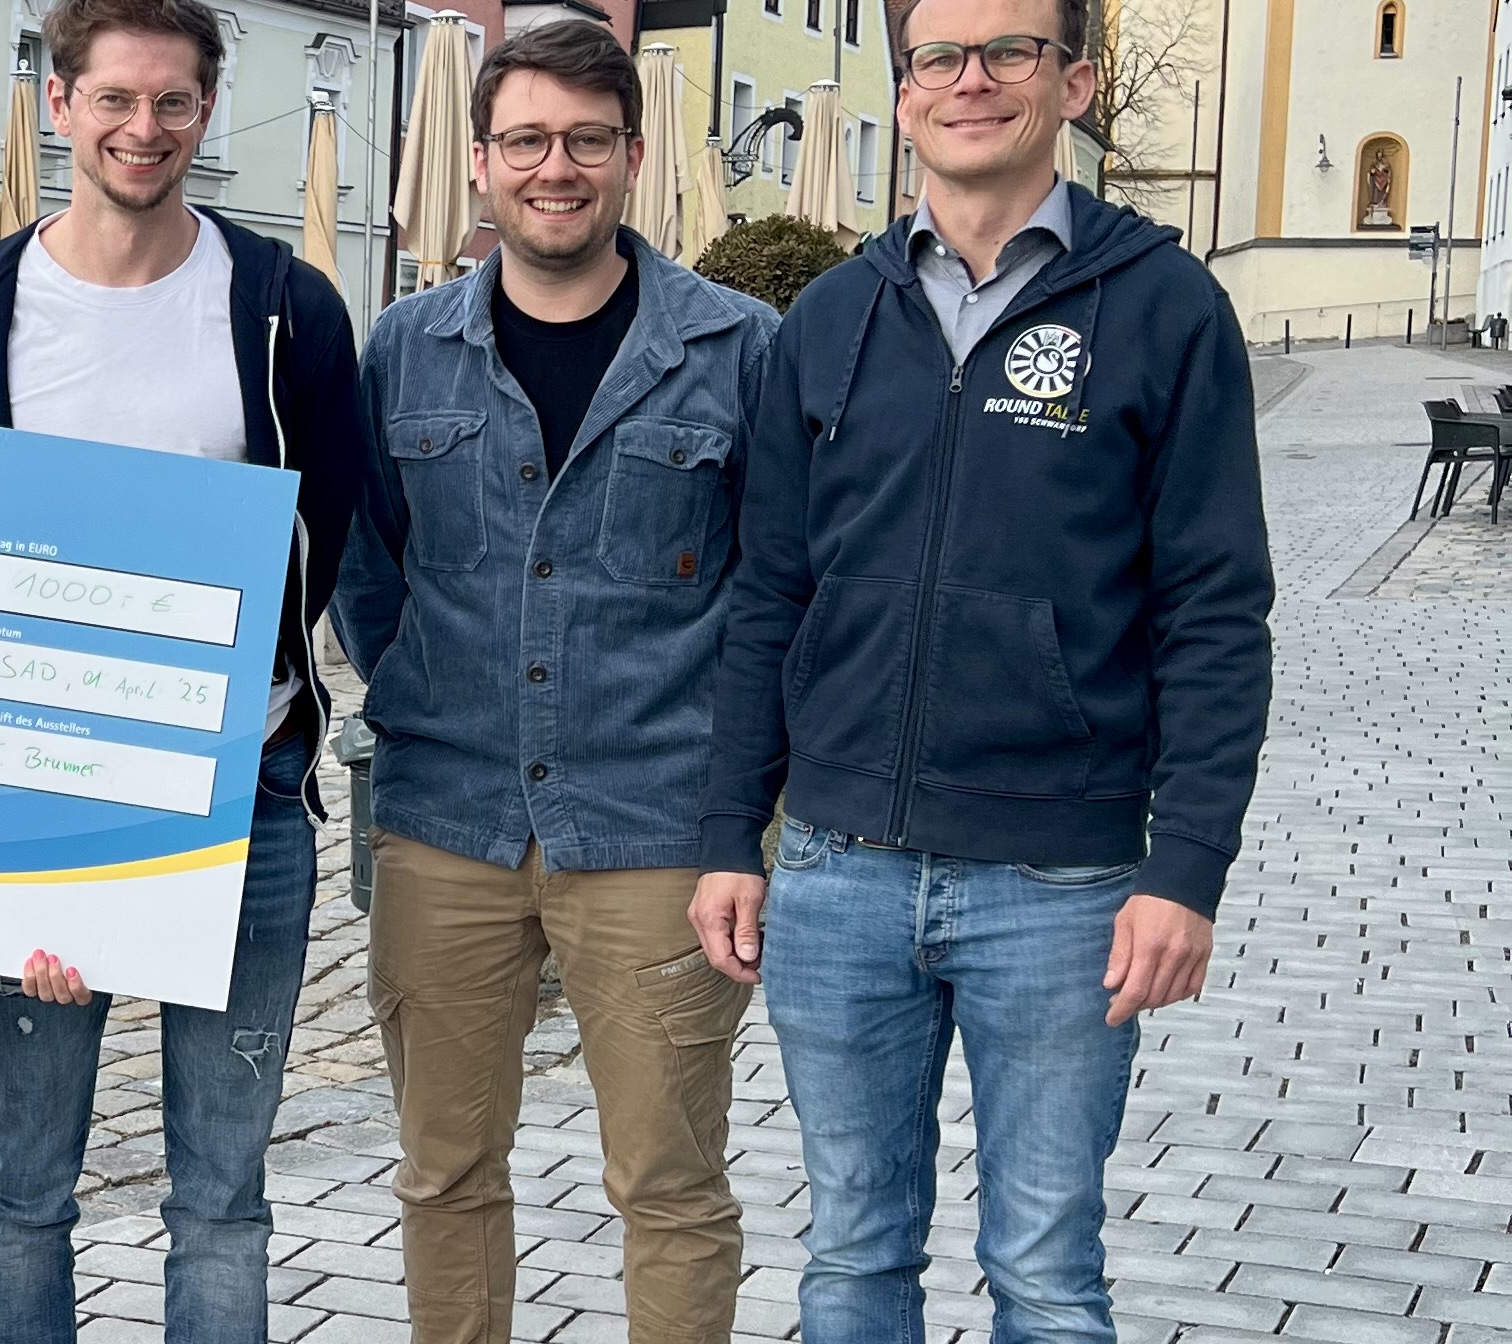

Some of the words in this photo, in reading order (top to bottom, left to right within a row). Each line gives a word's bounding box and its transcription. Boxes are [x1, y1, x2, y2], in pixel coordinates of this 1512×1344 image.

[983, 397, 1044, 415] ROUND
[15, 542, 26, 552] in
[28, 542, 58, 556] EURO
[150, 593, 176, 613] €
[114, 678, 157, 701] April
[15, 713, 33, 727] des
[35, 716, 91, 736] Ausstellers
